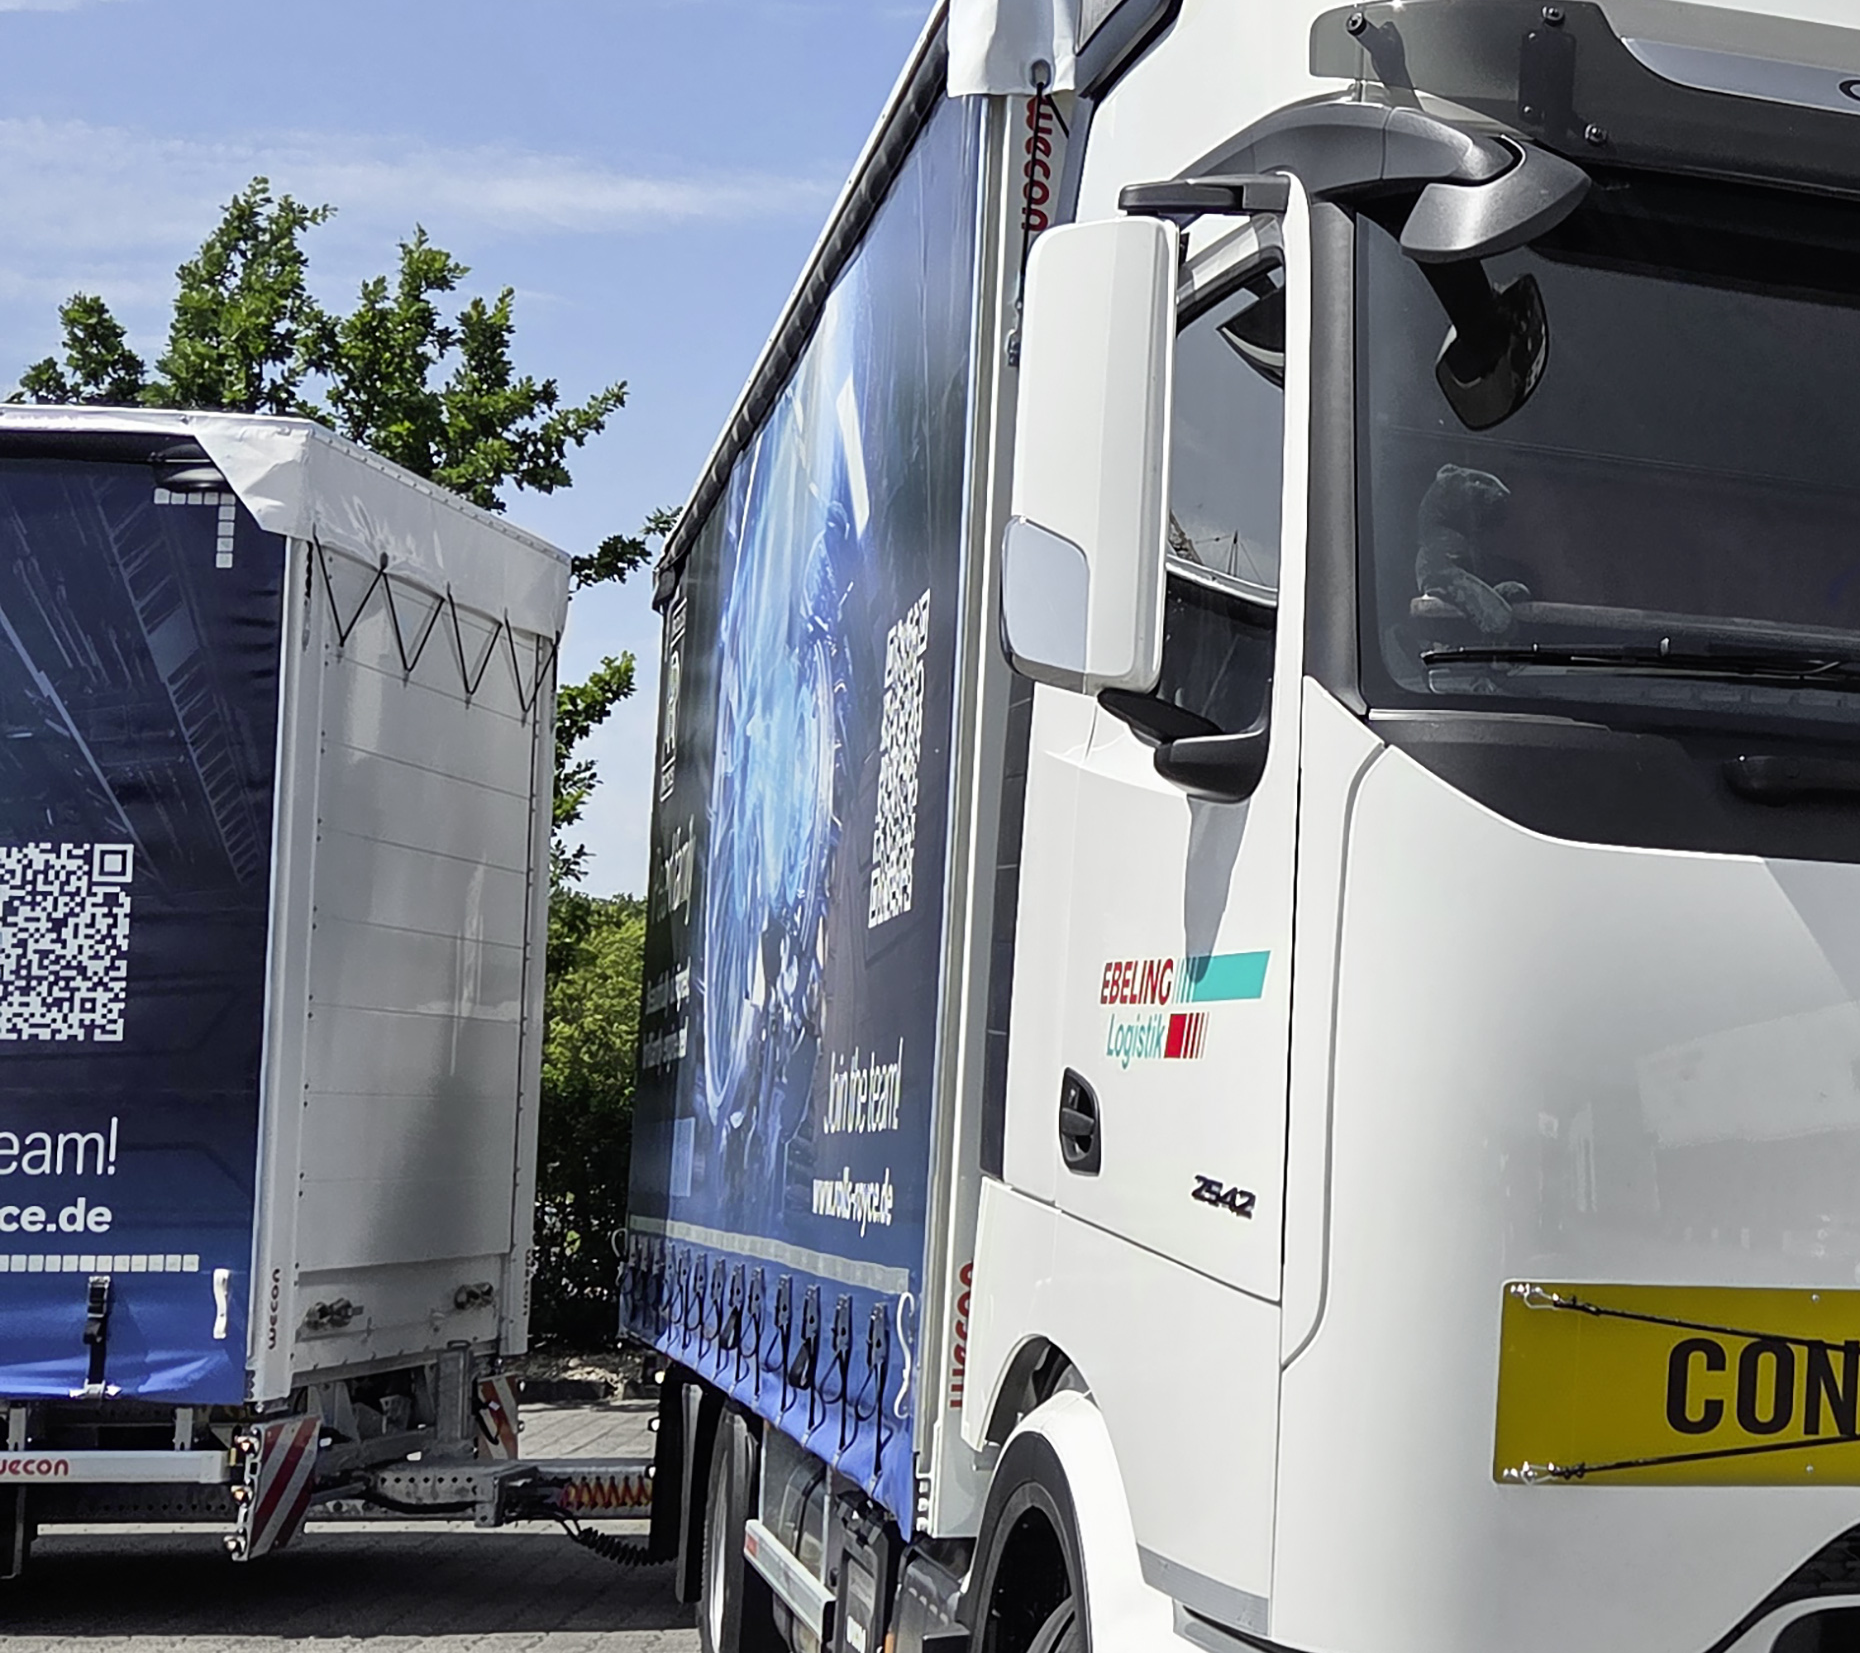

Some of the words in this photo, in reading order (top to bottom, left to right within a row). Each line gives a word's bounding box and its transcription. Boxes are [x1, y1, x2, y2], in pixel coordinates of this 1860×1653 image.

[1099, 957, 1174, 1006] EBELING
[1105, 1013, 1166, 1070] Logistik
[1190, 1173, 1257, 1220] 2542
